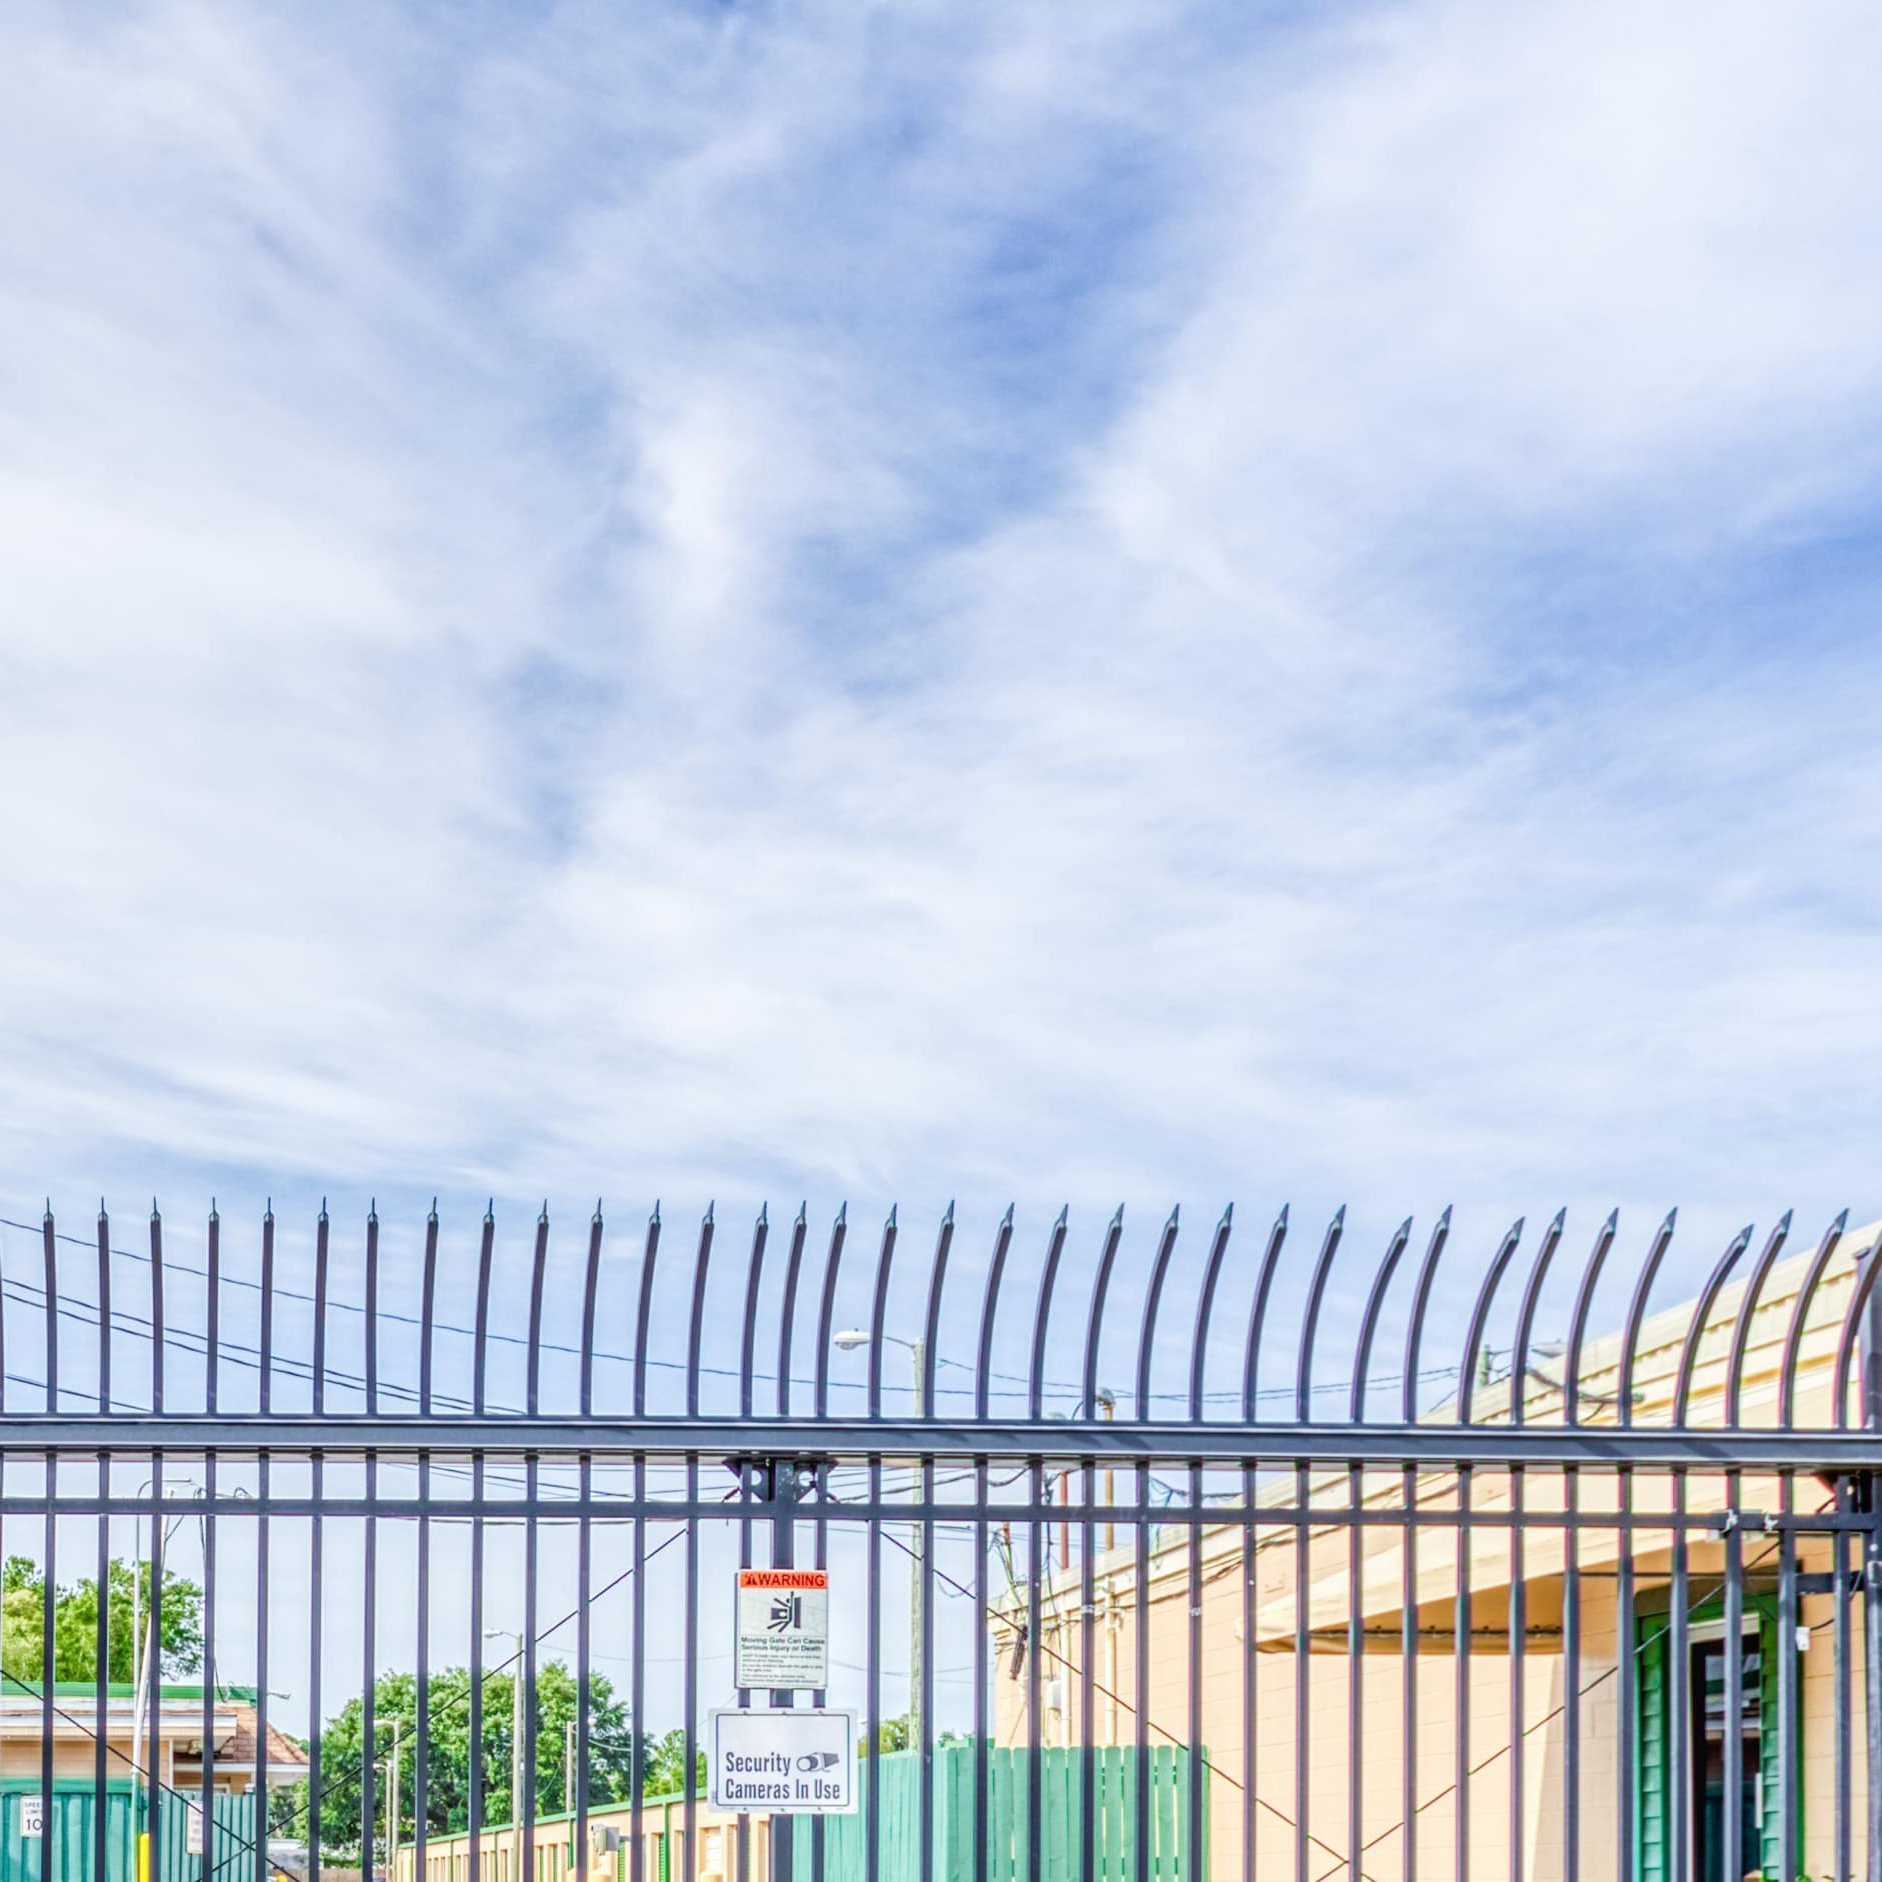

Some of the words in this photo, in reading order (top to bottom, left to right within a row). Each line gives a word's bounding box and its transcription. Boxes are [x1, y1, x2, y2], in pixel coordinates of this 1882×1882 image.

[758, 1574, 825, 1587] WARNING
[726, 1752, 791, 1776] Security
[726, 1778, 790, 1799] Cameras
[796, 1779, 809, 1799] In
[814, 1779, 840, 1799] Use
[26, 1818, 43, 1831] 10
